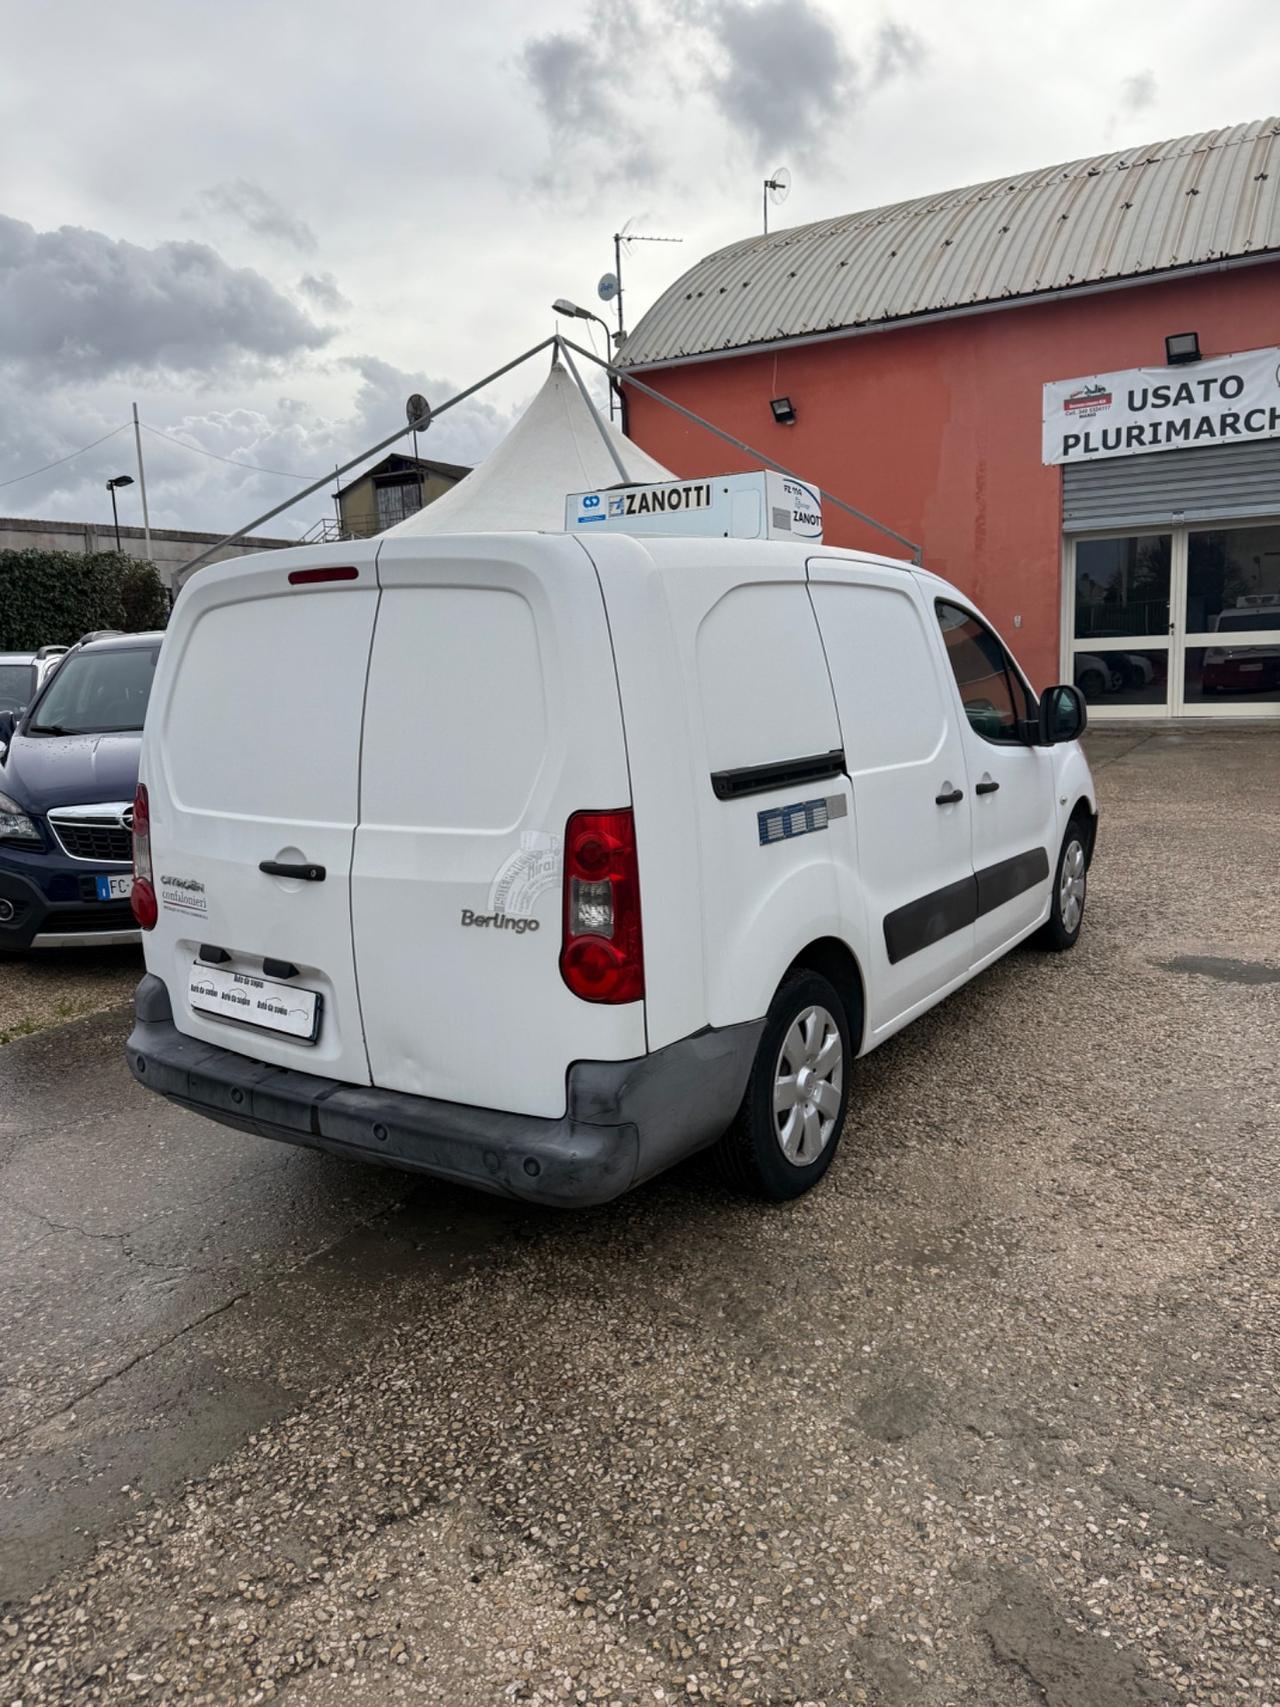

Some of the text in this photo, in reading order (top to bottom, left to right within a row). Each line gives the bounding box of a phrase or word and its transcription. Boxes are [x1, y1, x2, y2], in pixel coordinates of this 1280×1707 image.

[1128, 375, 1244, 412] USATO
[1063, 406, 1280, 456] PLURIMARCH
[626, 484, 711, 515] ZANOTTI
[793, 510, 822, 527] ZANOT
[110, 879, 127, 894] FC
[461, 909, 540, 935] Berlingo
